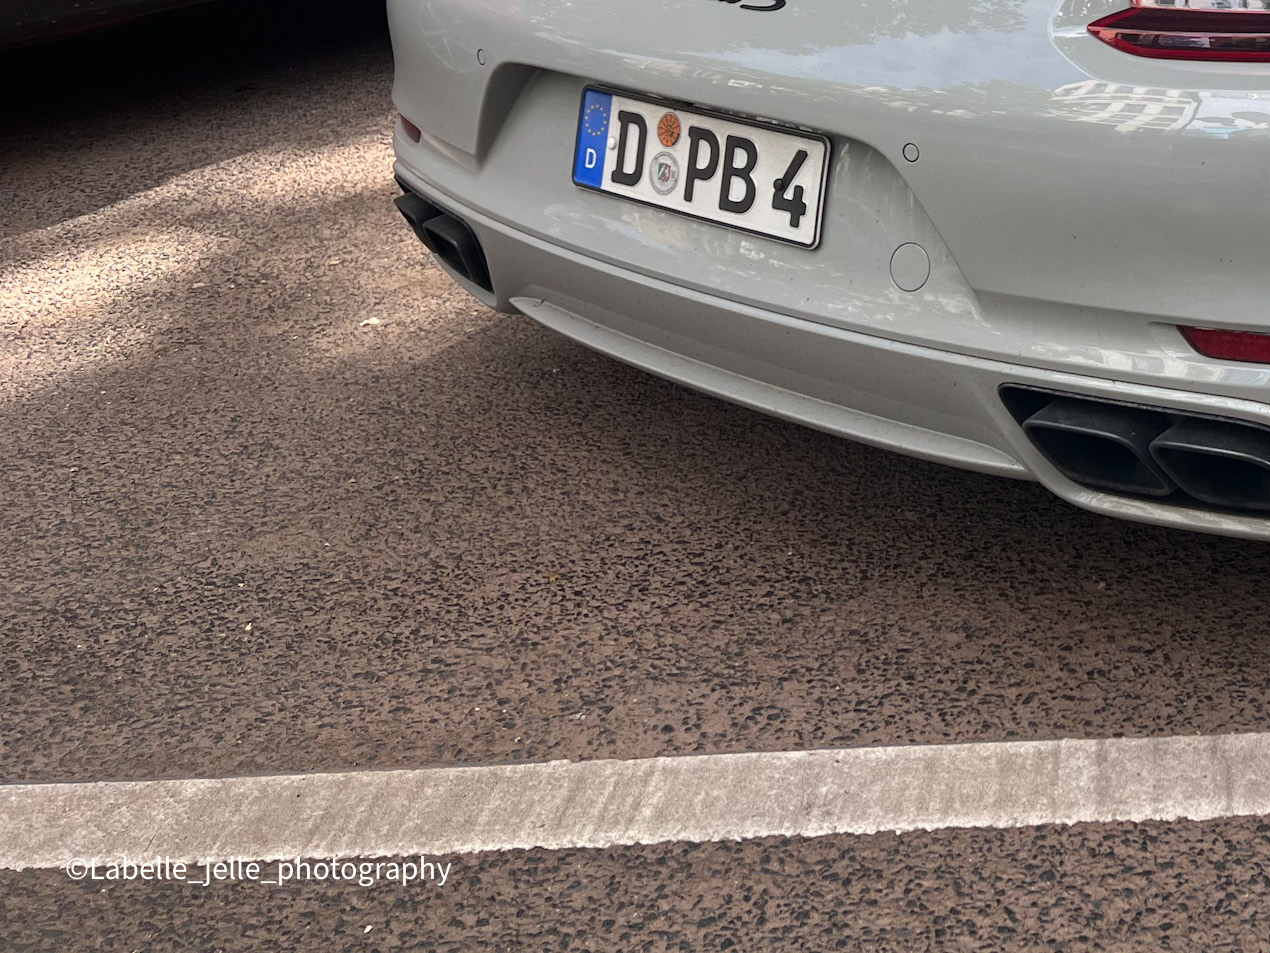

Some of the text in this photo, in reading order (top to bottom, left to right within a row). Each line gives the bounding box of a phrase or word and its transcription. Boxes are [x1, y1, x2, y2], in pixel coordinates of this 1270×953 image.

[585, 148, 597, 169] D
[611, 110, 648, 187] D
[683, 125, 758, 214] PB
[771, 149, 808, 228] 4
